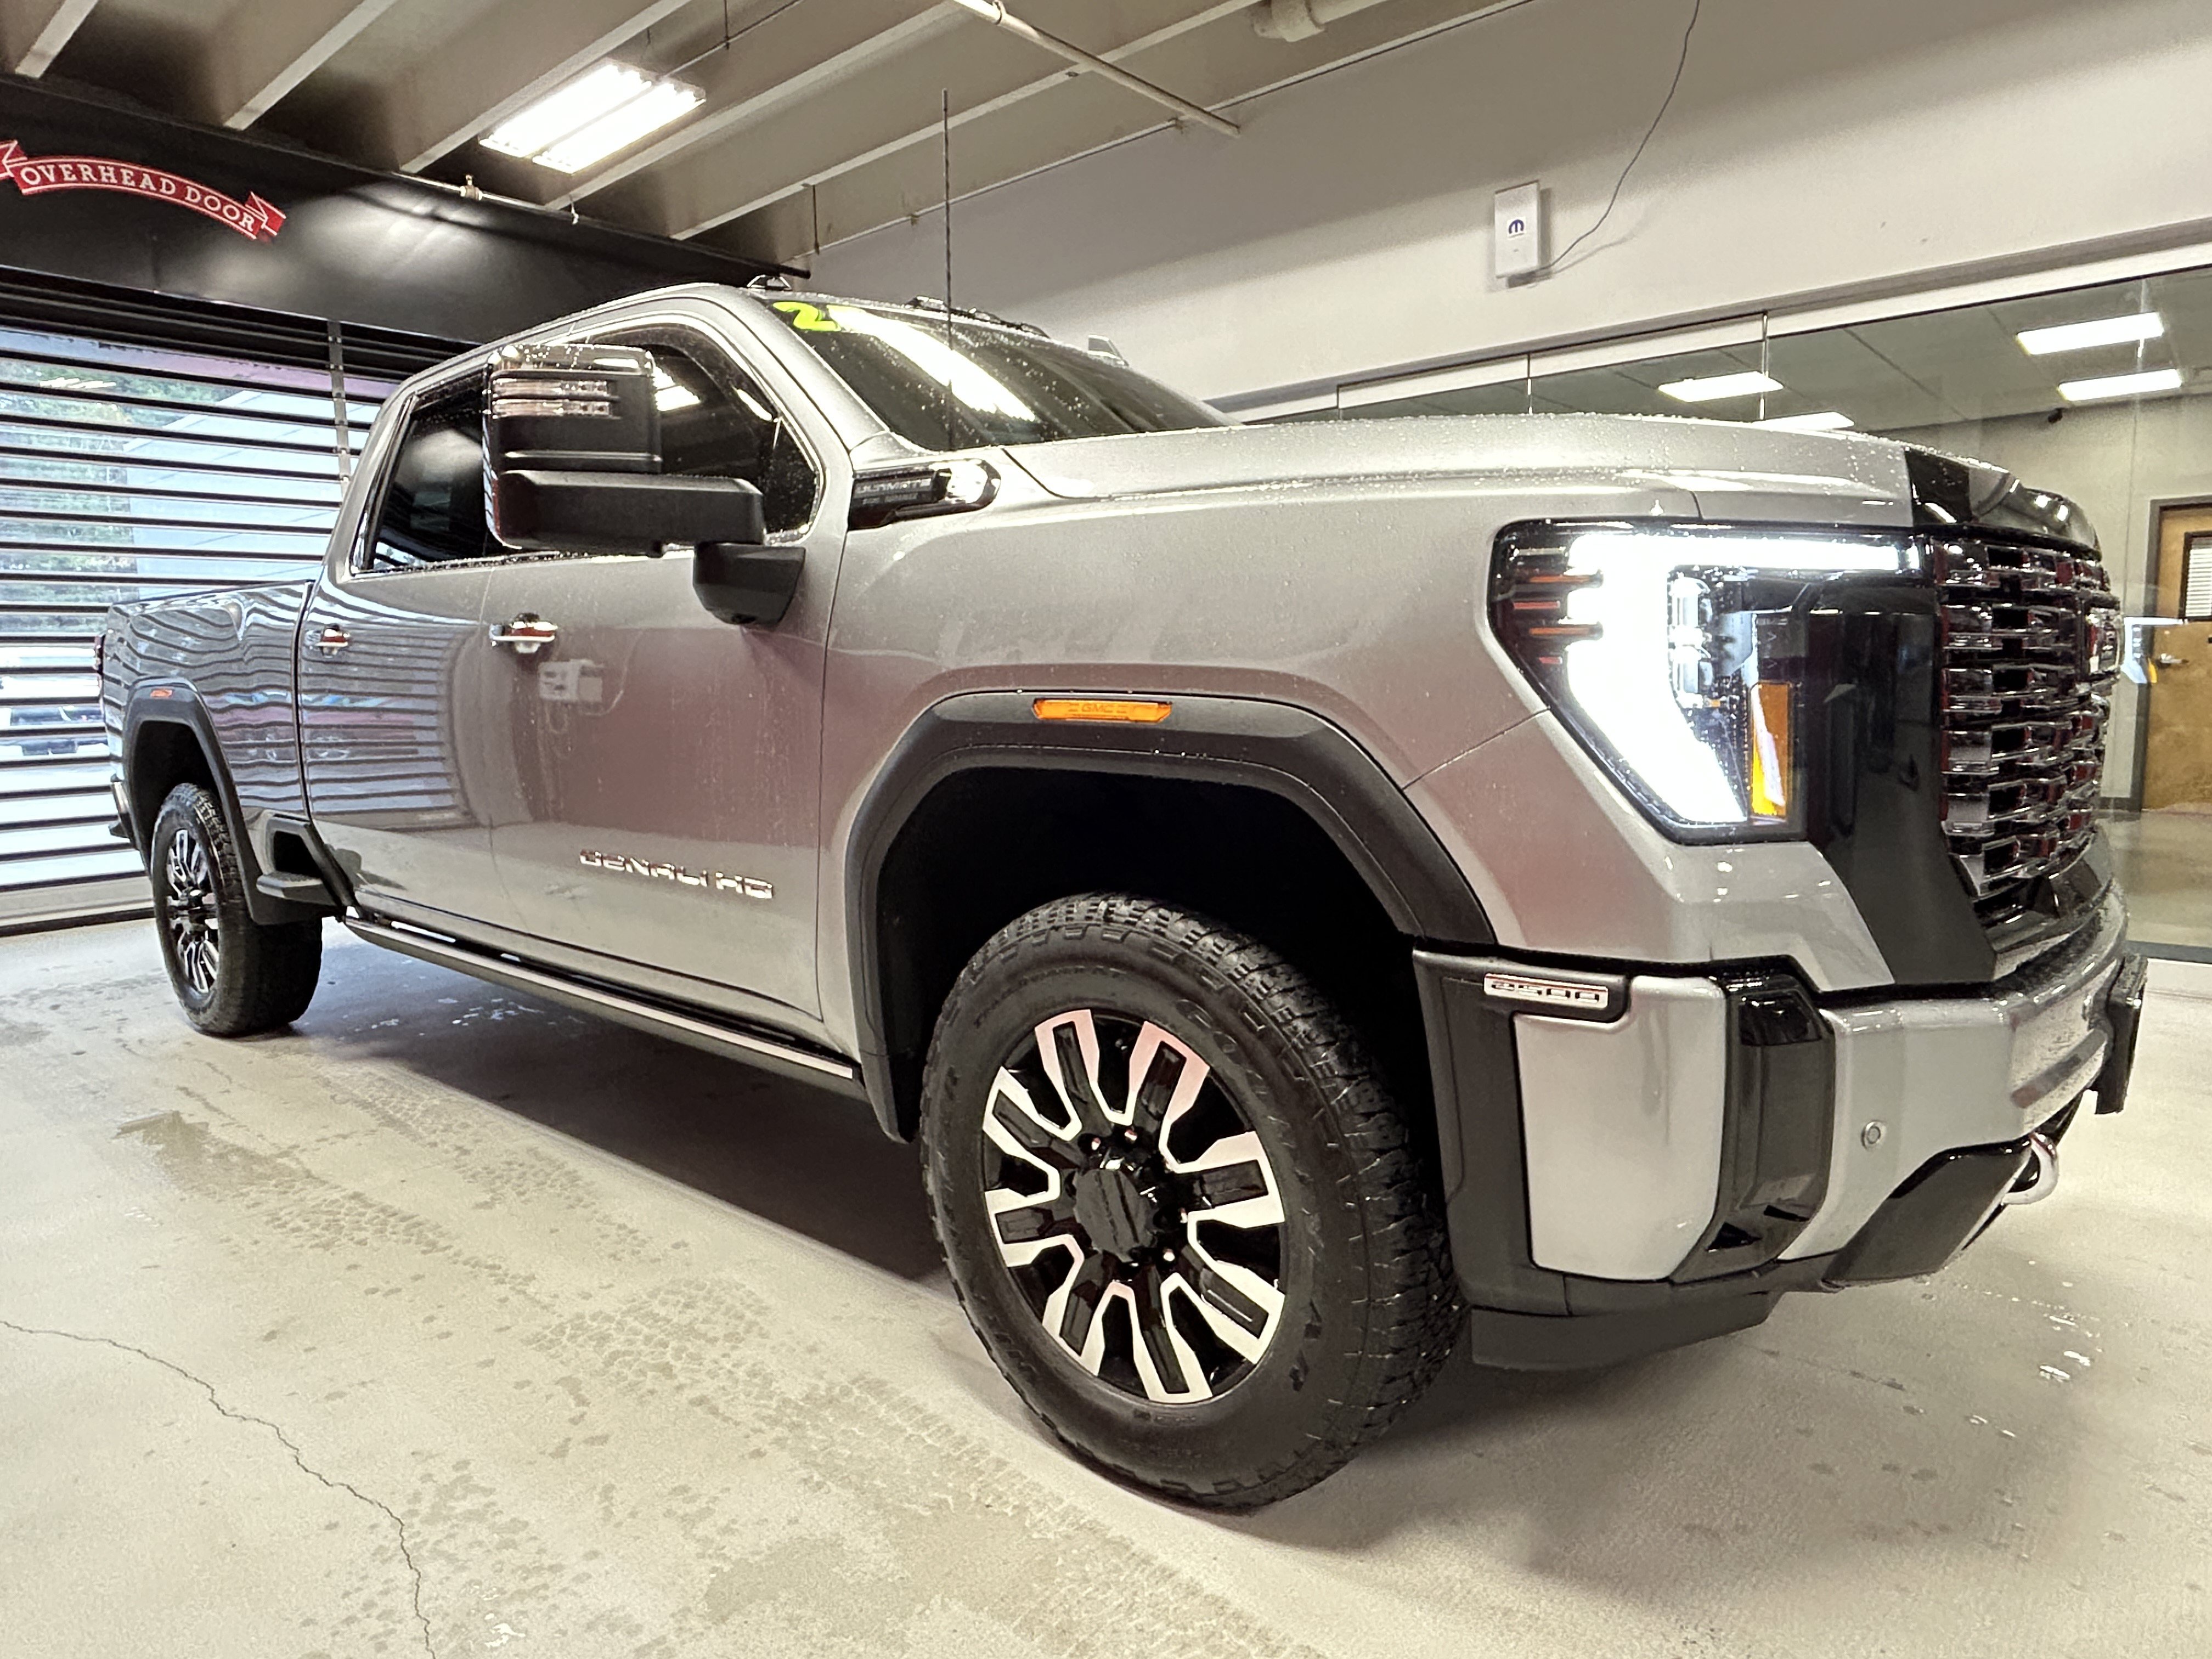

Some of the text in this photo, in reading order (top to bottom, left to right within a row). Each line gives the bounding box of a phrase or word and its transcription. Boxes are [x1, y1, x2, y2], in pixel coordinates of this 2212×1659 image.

[20, 163, 256, 232] OVERHEAD DOOR
[772, 302, 864, 332] 2
[1082, 702, 1114, 713] GMC
[579, 850, 774, 899] DENALI HD
[1491, 981, 1600, 1003] 2500
